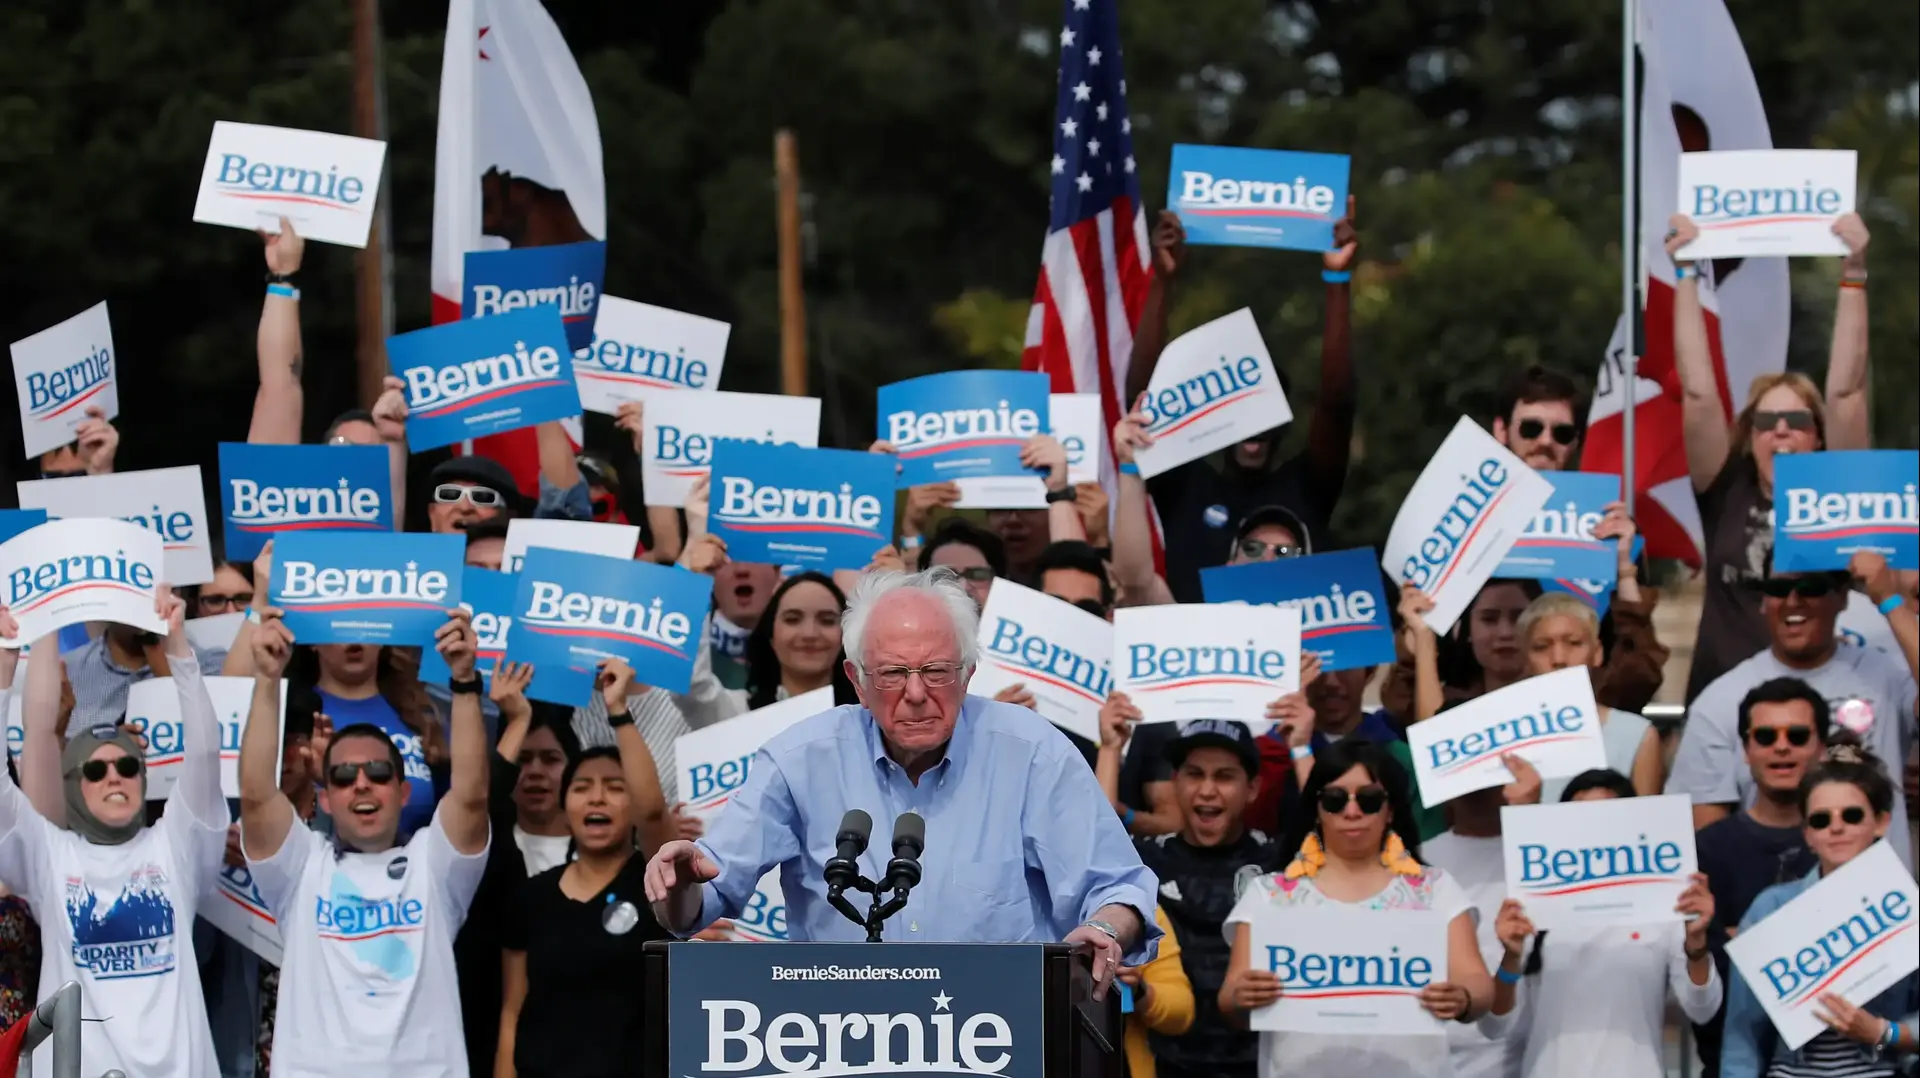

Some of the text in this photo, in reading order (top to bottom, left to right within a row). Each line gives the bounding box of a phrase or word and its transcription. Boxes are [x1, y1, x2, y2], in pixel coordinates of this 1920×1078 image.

[216, 153, 364, 204] Bernie
[1182, 170, 1335, 214] Bernie
[1693, 180, 1841, 217] Bernie
[26, 344, 110, 409] Bernie
[404, 340, 560, 404] Bernie
[888, 399, 1040, 446] Bernie
[229, 476, 380, 521] Bernie
[719, 476, 881, 529] Bernie
[1785, 483, 1919, 530] Berni
[1403, 458, 1507, 589] Bernie
[8, 549, 153, 605] Bernie
[280, 559, 448, 600] Bernie
[526, 580, 691, 647] Bernie
[987, 615, 1116, 698] Berni
[1128, 639, 1285, 680] Bernie
[1429, 703, 1584, 770] Bernie
[1519, 834, 1683, 882] Bernie
[316, 893, 422, 934] Bernie
[1266, 945, 1432, 987] Bernie
[1761, 889, 1912, 1000] Bernie
[771, 964, 941, 981] BernieSanders.com
[701, 989, 1014, 1074] Bernie
